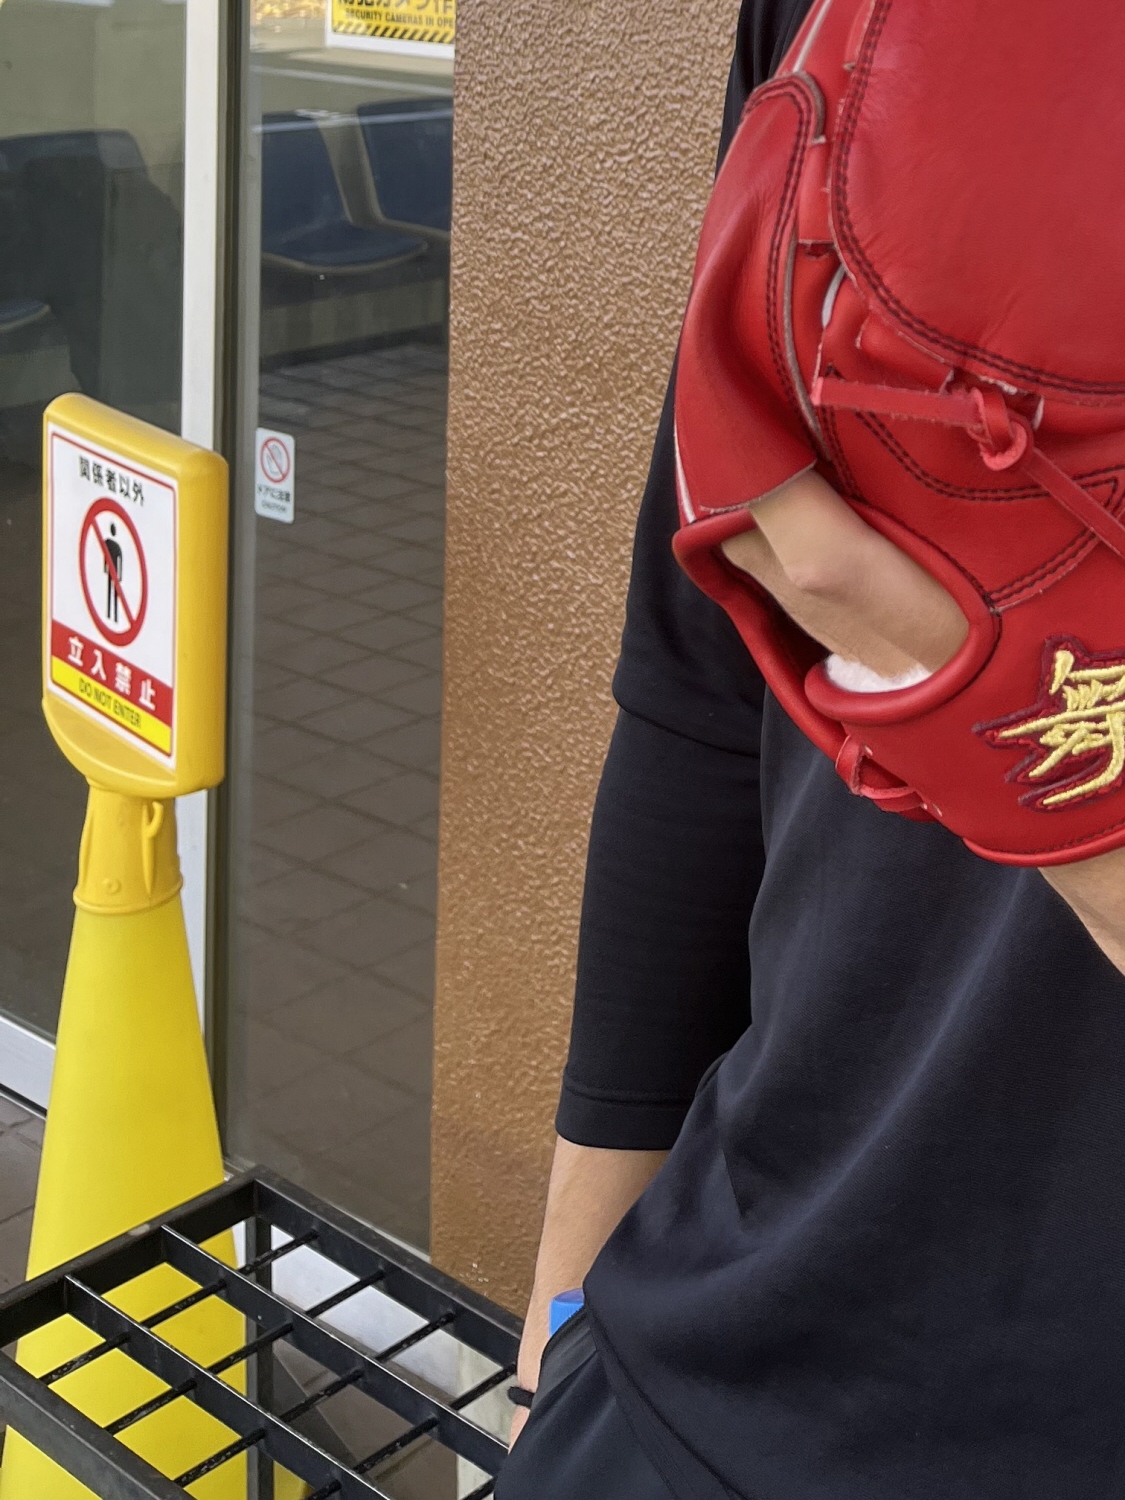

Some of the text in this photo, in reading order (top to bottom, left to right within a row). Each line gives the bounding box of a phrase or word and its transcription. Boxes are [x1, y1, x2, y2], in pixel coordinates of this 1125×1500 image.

[385, 11, 423, 25] CAMERAS
[425, 14, 434, 26] IN
[79, 454, 145, 507] 関係者以外
[67, 636, 157, 711] 立入禁止
[78, 677, 142, 729] DO NOT ENTER
